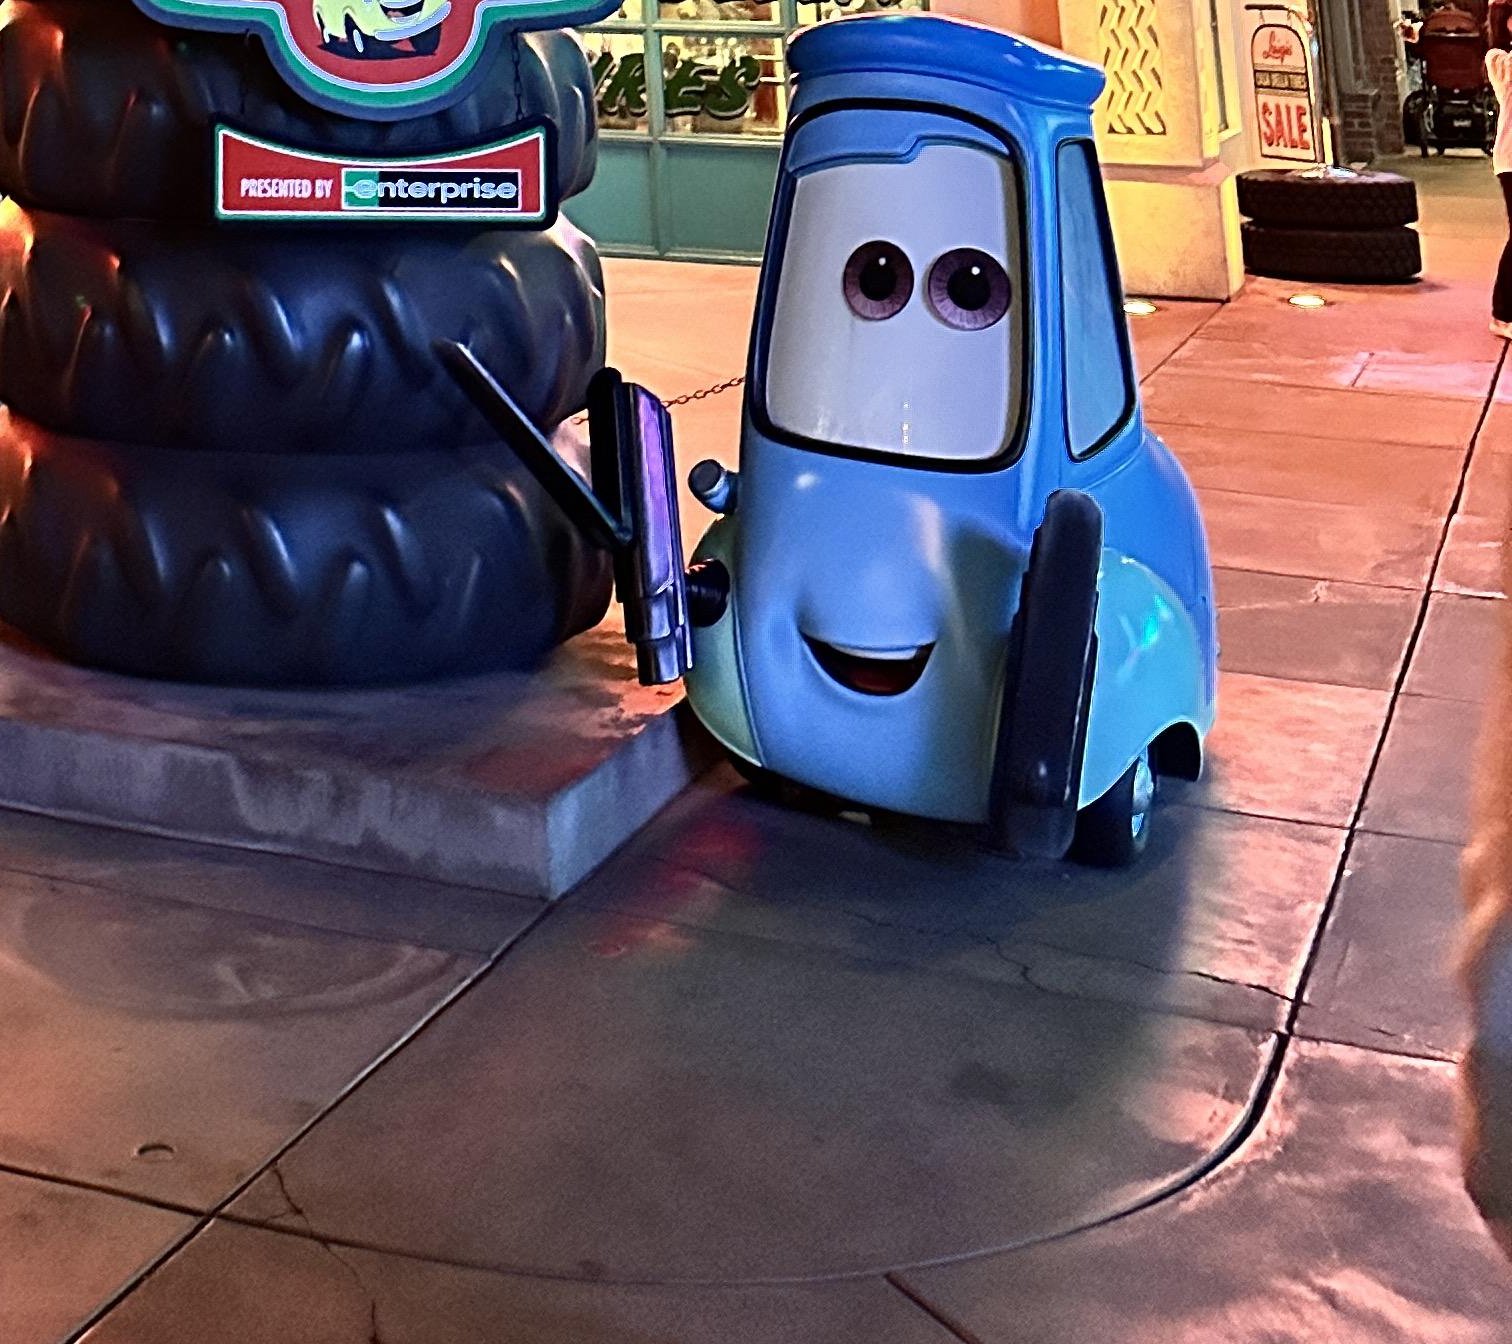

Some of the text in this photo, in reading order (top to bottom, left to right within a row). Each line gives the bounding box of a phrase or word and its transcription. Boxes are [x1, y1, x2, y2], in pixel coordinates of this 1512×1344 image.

[592, 50, 761, 120] IRES
[1261, 101, 1311, 150] SALE
[240, 177, 517, 204] PRESENTED BY enterprise
